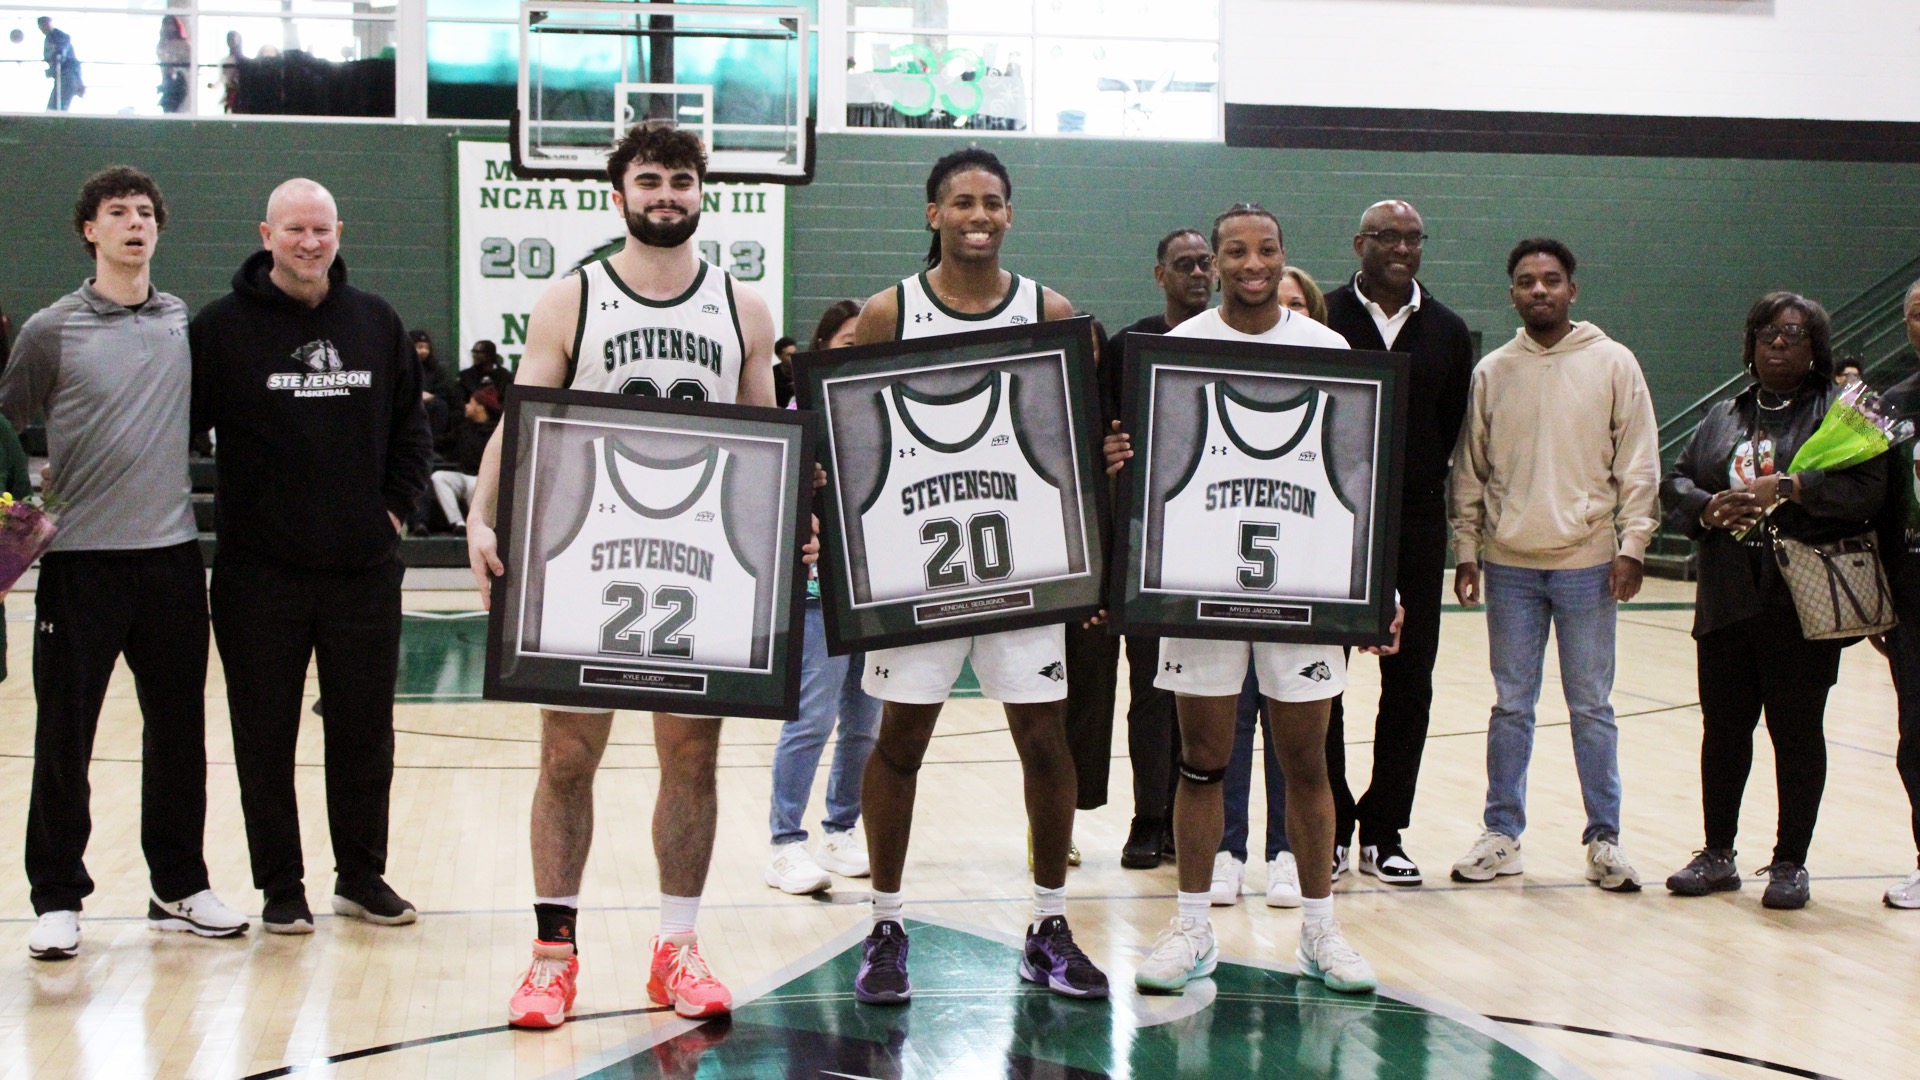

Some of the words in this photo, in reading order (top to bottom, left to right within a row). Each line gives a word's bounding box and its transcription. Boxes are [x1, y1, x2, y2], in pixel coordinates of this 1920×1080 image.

[889, 43, 985, 117] 33
[480, 187, 568, 210] NCAA
[732, 192, 766, 213] III
[480, 237, 555, 279] 20
[698, 241, 765, 281] 13
[603, 327, 722, 378] STEVENSON
[267, 371, 371, 389] STEVENSON
[294, 388, 350, 397] BASKETBALL
[901, 470, 1018, 516] STEVENSON
[1205, 478, 1317, 519] STEVENSON
[590, 538, 715, 583] STEVENSON
[919, 510, 1015, 590] 20
[1236, 520, 1280, 591] 5
[598, 581, 697, 660] 22
[940, 602, 969, 612] KENDALL
[1251, 607, 1280, 615] JACKSON
[622, 673, 640, 681] KYLE
